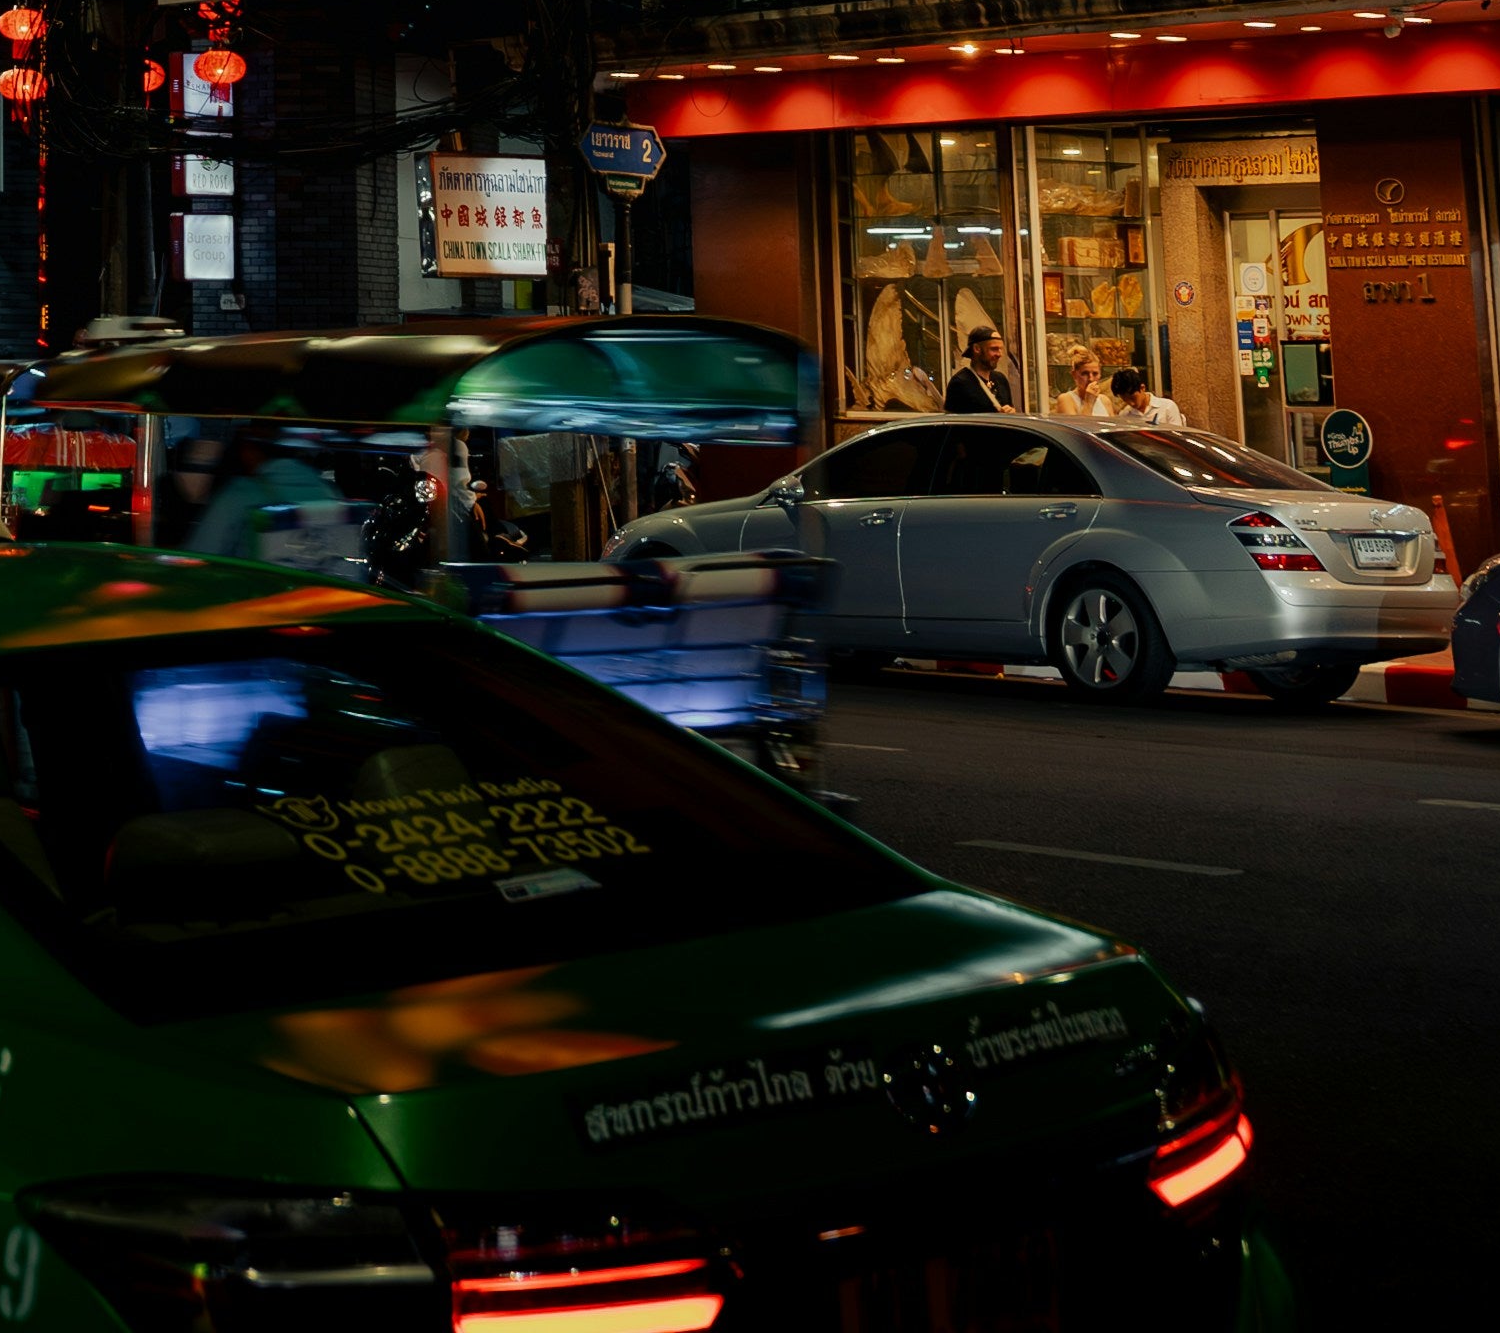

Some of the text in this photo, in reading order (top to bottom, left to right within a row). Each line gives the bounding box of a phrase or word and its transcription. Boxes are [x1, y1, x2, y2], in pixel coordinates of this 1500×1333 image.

[591, 131, 652, 163] เยาวราช 2
[192, 248, 226, 264] Group
[443, 240, 465, 260] CHINA
[465, 241, 487, 261] TOWN
[488, 242, 512, 261] SCALA
[337, 776, 563, 818] Howa Taxi Radio
[303, 796, 609, 862] 0-2424-2222
[343, 825, 651, 894] 0-8888-73502
